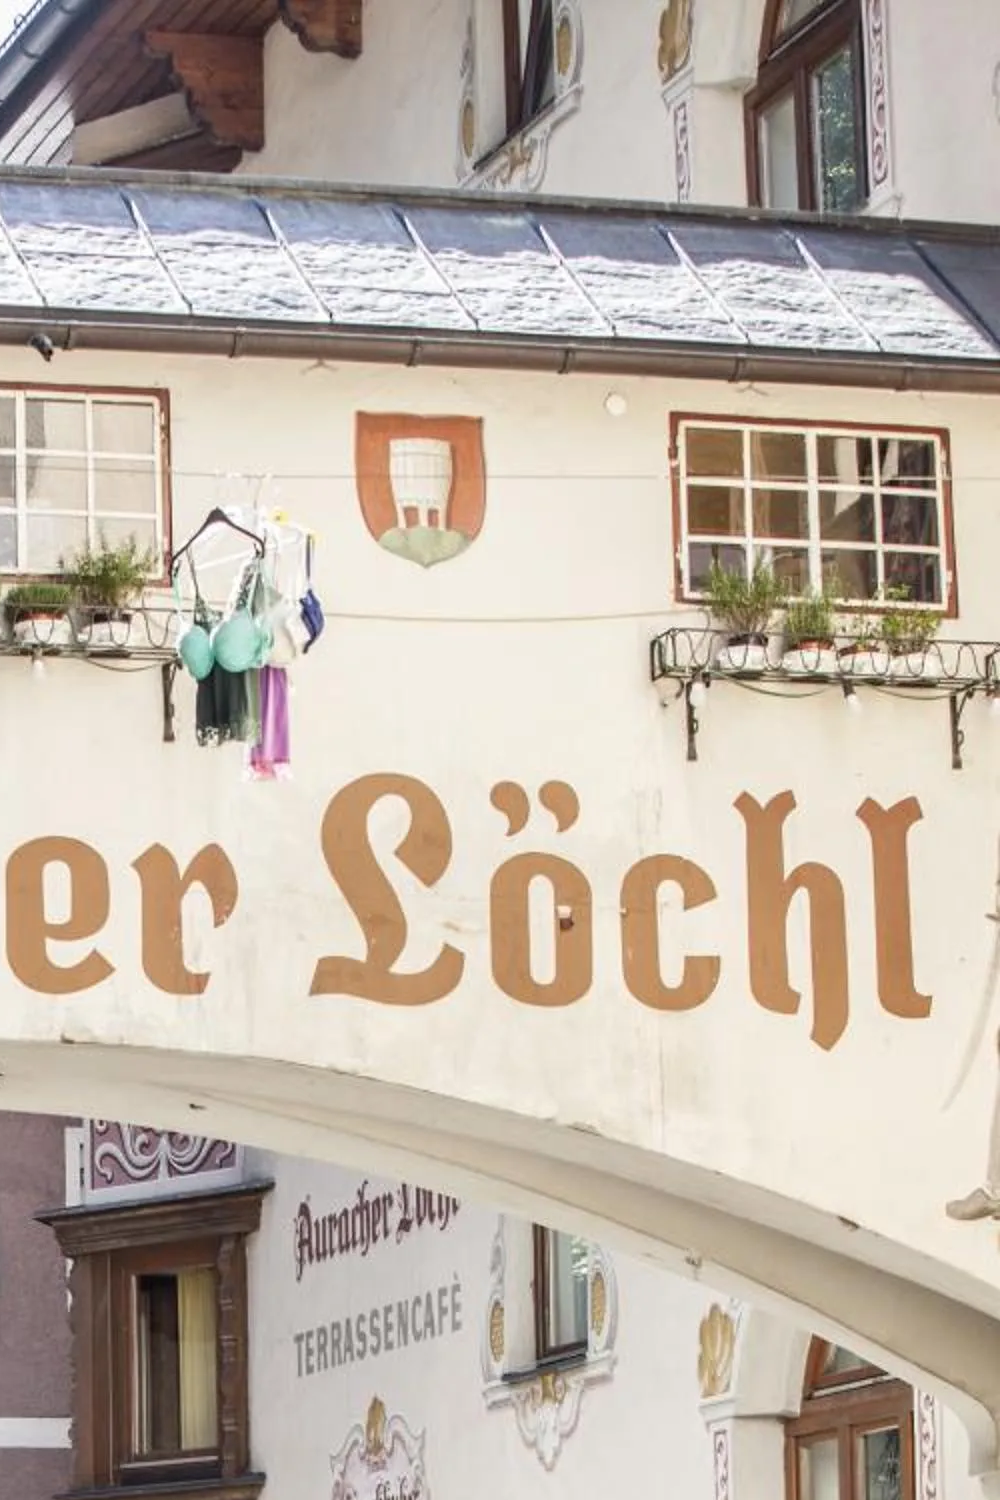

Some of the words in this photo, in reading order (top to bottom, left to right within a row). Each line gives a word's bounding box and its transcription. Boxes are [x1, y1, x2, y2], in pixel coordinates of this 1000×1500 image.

[309, 772, 933, 1052] Löchl
[293, 1179, 393, 1283] Auracher
[294, 1272, 462, 1378] TERRASSENCAFÉ
